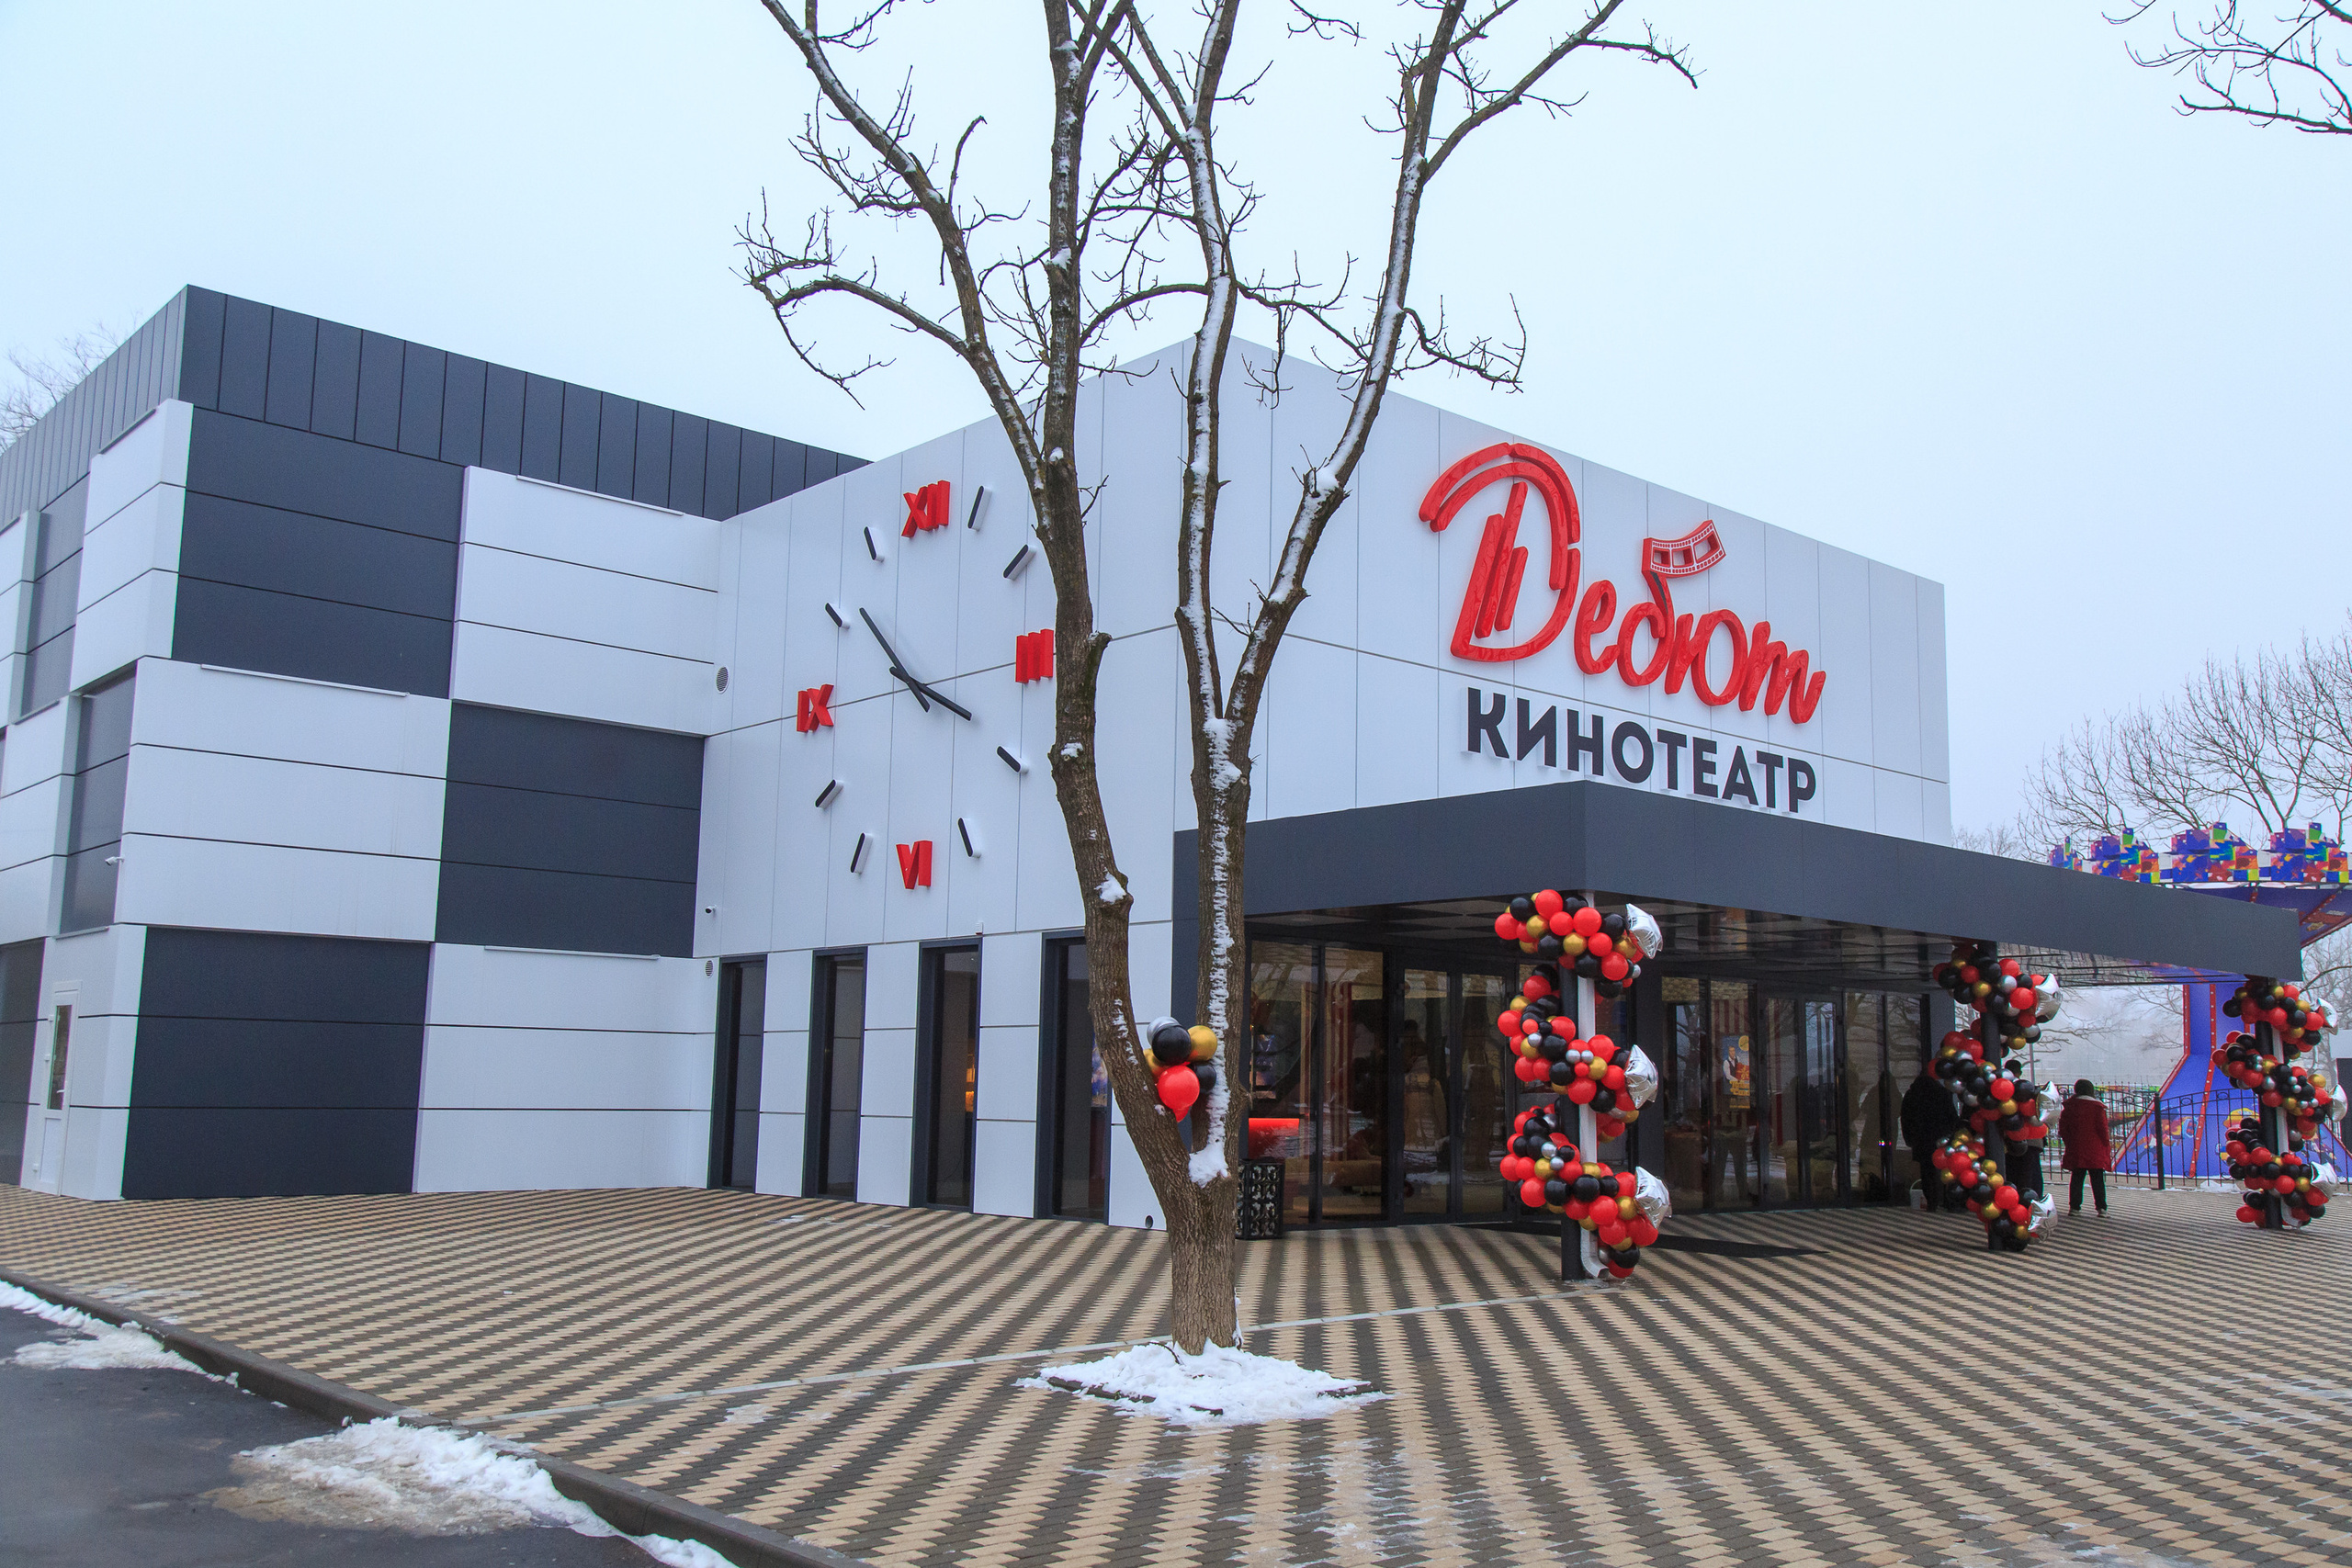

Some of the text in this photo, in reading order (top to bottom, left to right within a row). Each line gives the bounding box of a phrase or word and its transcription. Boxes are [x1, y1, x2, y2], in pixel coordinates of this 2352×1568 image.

[901, 479, 951, 538] XII
[1419, 442, 1826, 725] Дебют
[797, 683, 834, 733] IX
[1467, 686, 1817, 814] КИНОТЕАТР
[896, 840, 933, 890] VI
